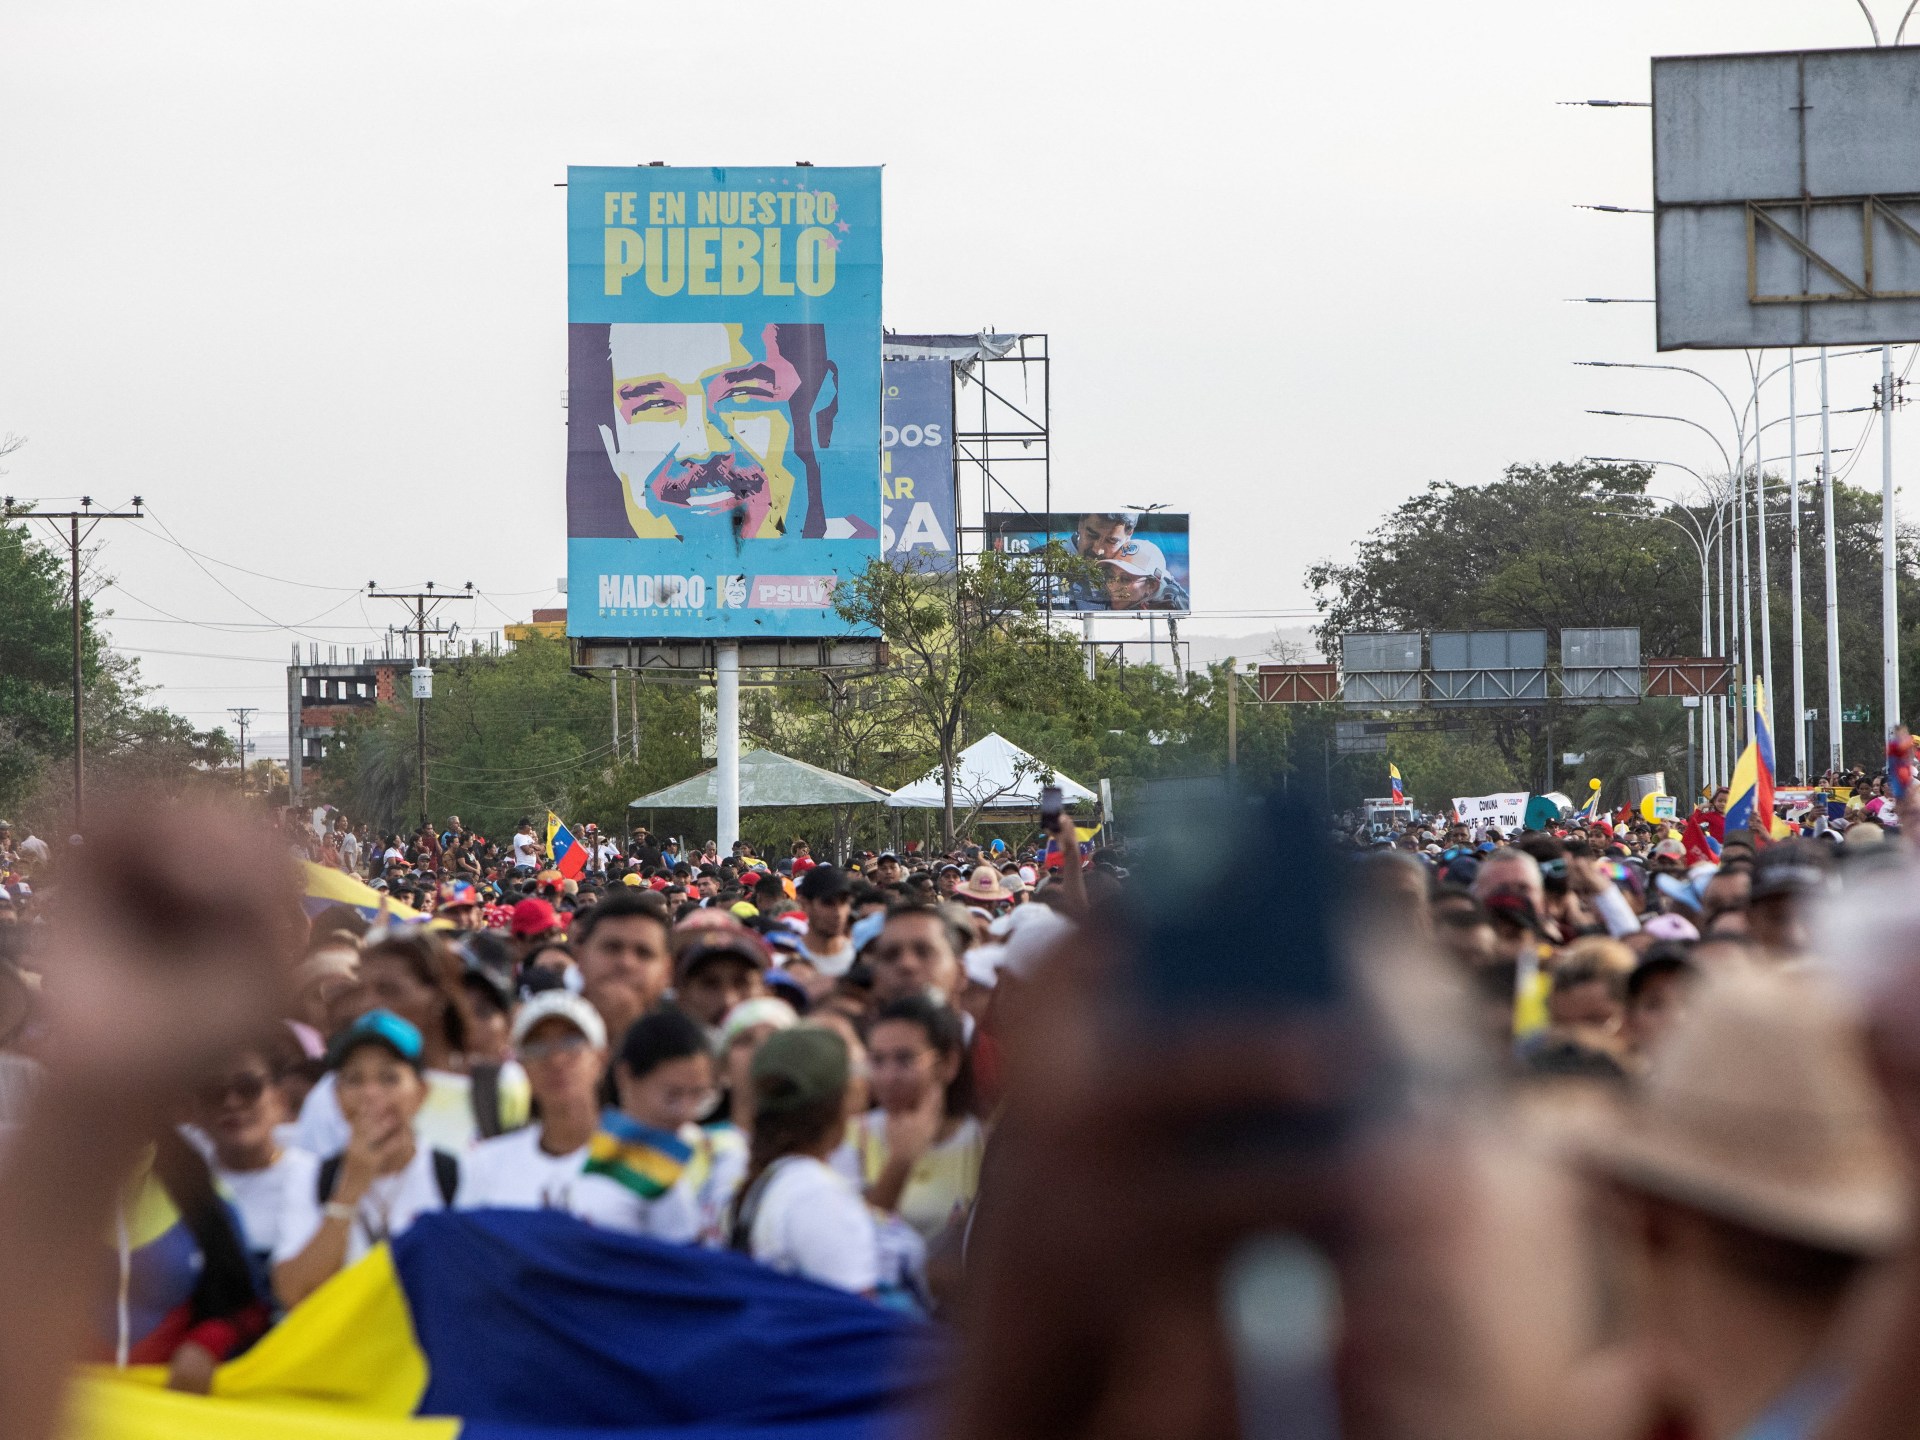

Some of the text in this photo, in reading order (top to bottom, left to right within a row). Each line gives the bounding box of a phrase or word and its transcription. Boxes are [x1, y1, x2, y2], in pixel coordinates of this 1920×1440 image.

[604, 191, 836, 225] FE EN NUESTRO
[604, 227, 836, 296] PUEBLO
[882, 502, 950, 552] A
[599, 574, 705, 609] MADURO
[599, 609, 703, 618] PRESIDENTE
[1479, 799, 1498, 811] COMUNA
[1483, 816, 1495, 826] DE
[1500, 812, 1518, 826] TIMÓN
